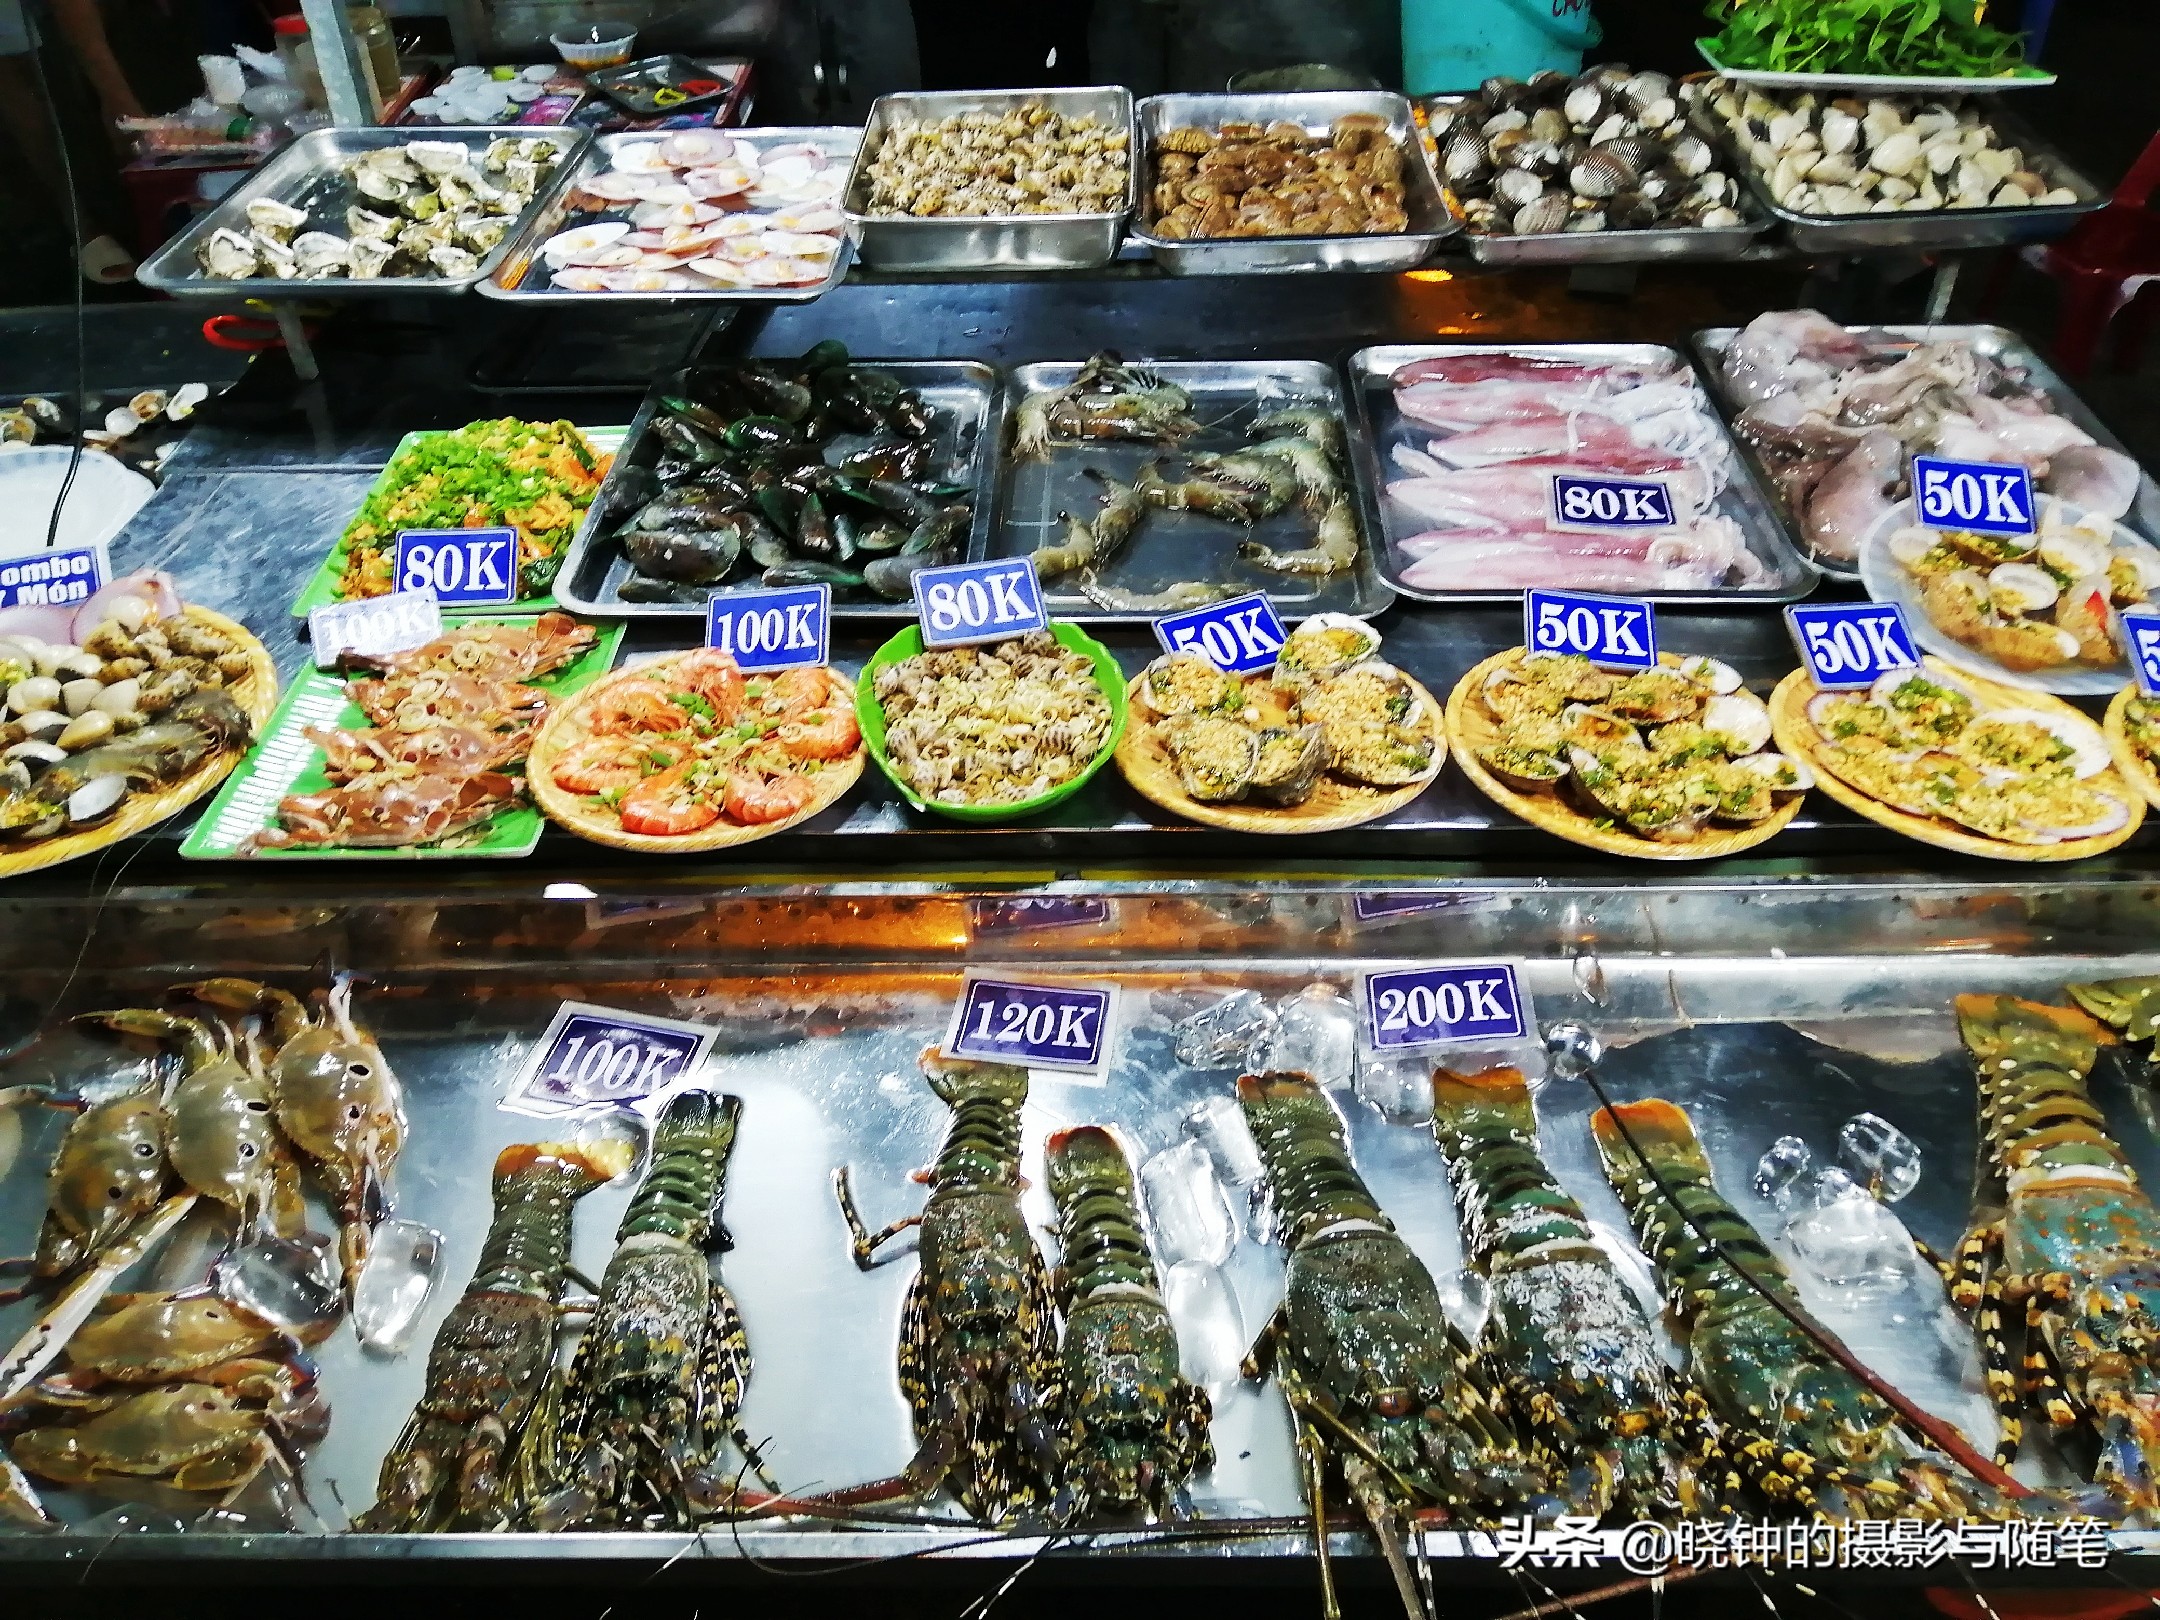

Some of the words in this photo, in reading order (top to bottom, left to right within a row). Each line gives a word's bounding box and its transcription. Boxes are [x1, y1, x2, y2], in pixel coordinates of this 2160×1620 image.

[1565, 487, 1664, 521] 80K
[1924, 471, 2028, 524] 50K
[0, 555, 90, 587] ombo
[402, 541, 506, 593] 80K
[322, 602, 428, 650] 100K
[927, 571, 1037, 631] 80K
[717, 603, 819, 655] 100K
[1536, 602, 1649, 657] 50K
[1806, 616, 1918, 674] 50K
[969, 1002, 1099, 1049] 120K
[1379, 979, 1512, 1032] 200K
[550, 1035, 684, 1094] 100K
